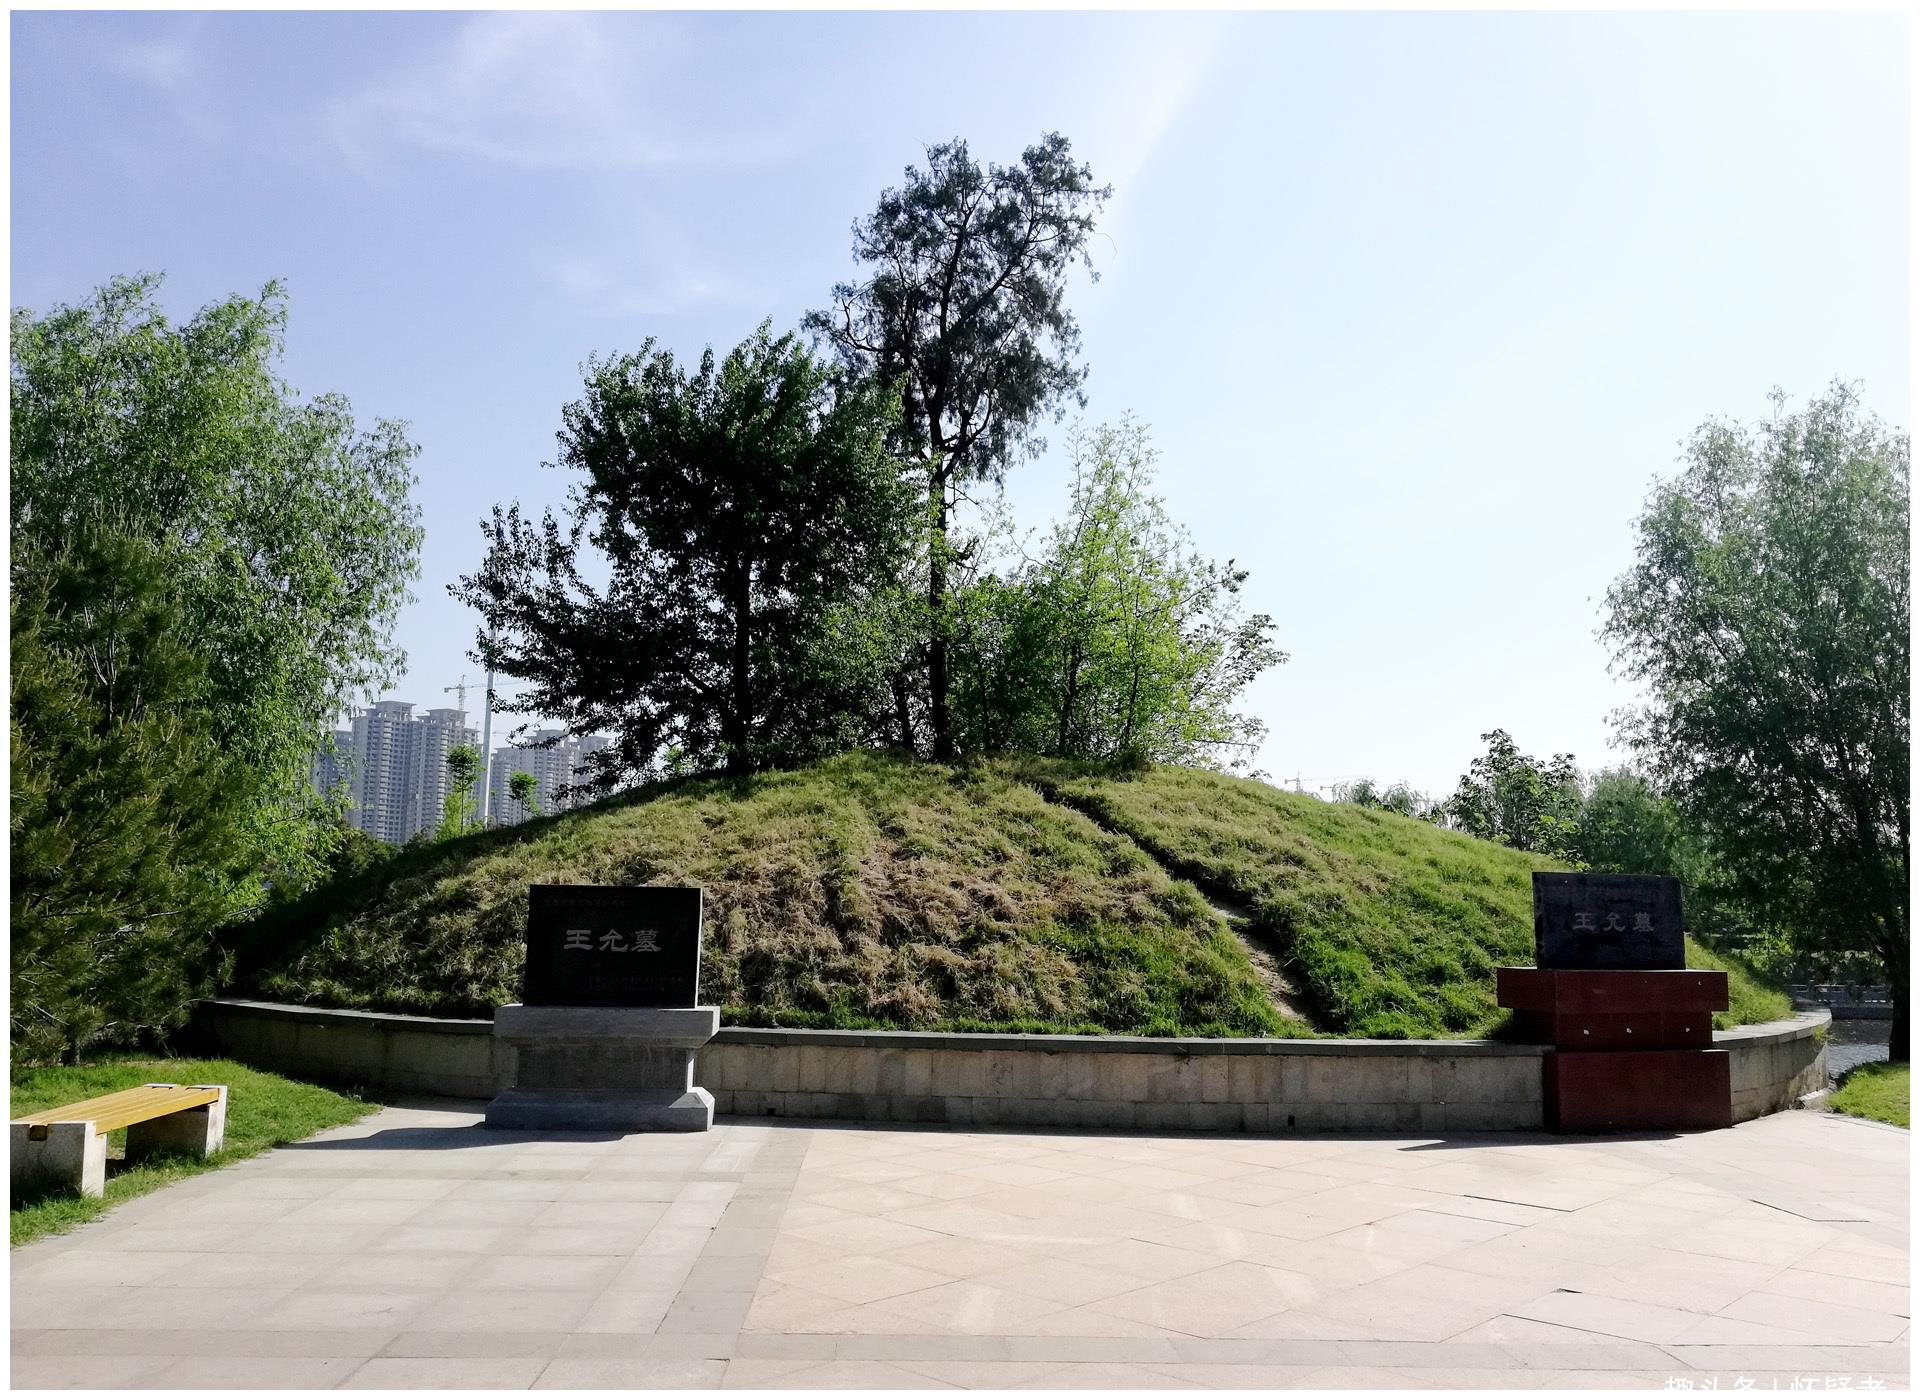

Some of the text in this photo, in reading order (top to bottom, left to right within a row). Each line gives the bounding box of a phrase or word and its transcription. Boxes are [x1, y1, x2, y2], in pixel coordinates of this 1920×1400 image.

[1572, 911, 1654, 932] 王允墓
[563, 929, 661, 952] 王允墓
